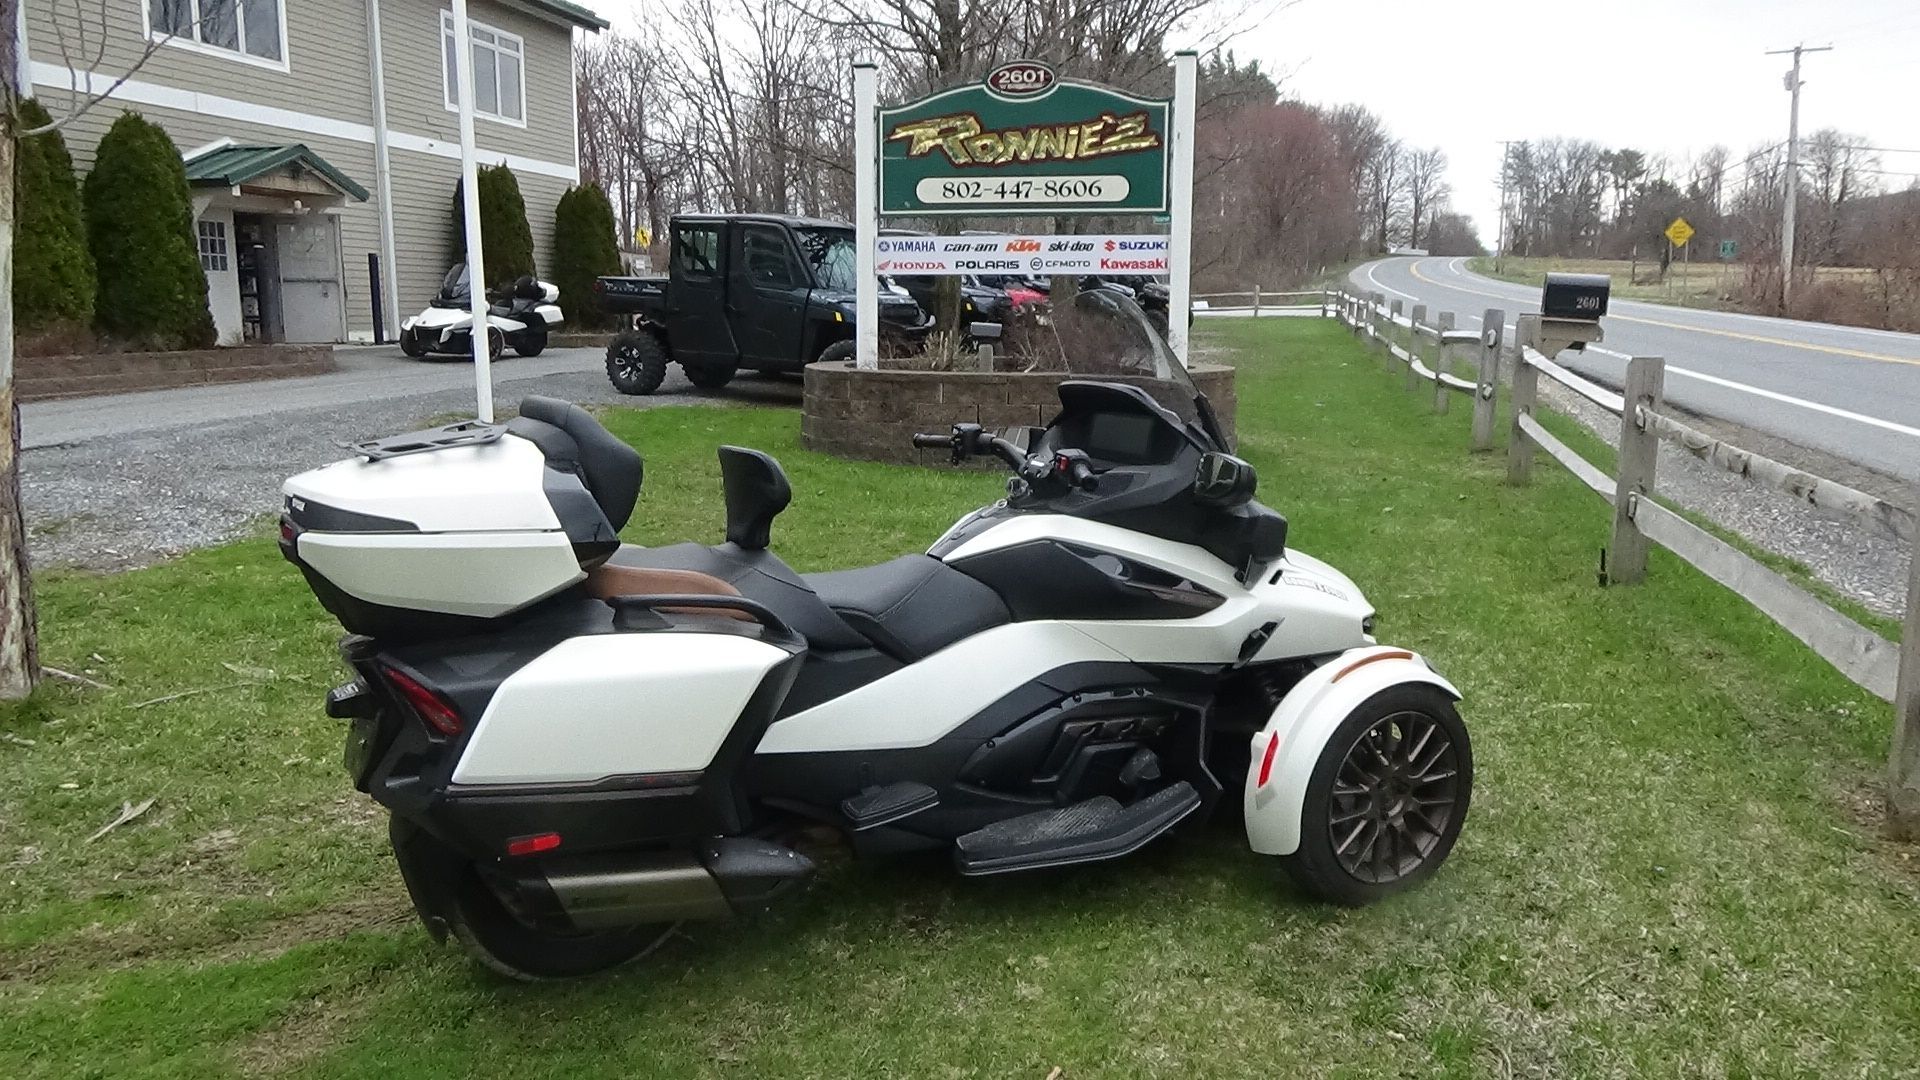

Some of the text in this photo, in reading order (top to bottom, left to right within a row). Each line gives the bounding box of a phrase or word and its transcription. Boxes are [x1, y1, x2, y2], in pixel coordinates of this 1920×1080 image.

[999, 70, 1045, 83] 2601
[942, 180, 1103, 199] 802-447-8606
[891, 240, 936, 252] YAMAHA
[1005, 239, 1042, 252] KTM
[1048, 240, 1095, 252] ski-doo
[1118, 241, 1169, 250] SUZUKI
[892, 257, 1169, 270] HONDA POLARIS CFMOTO Kawasaki
[1575, 296, 1600, 309] 2601
